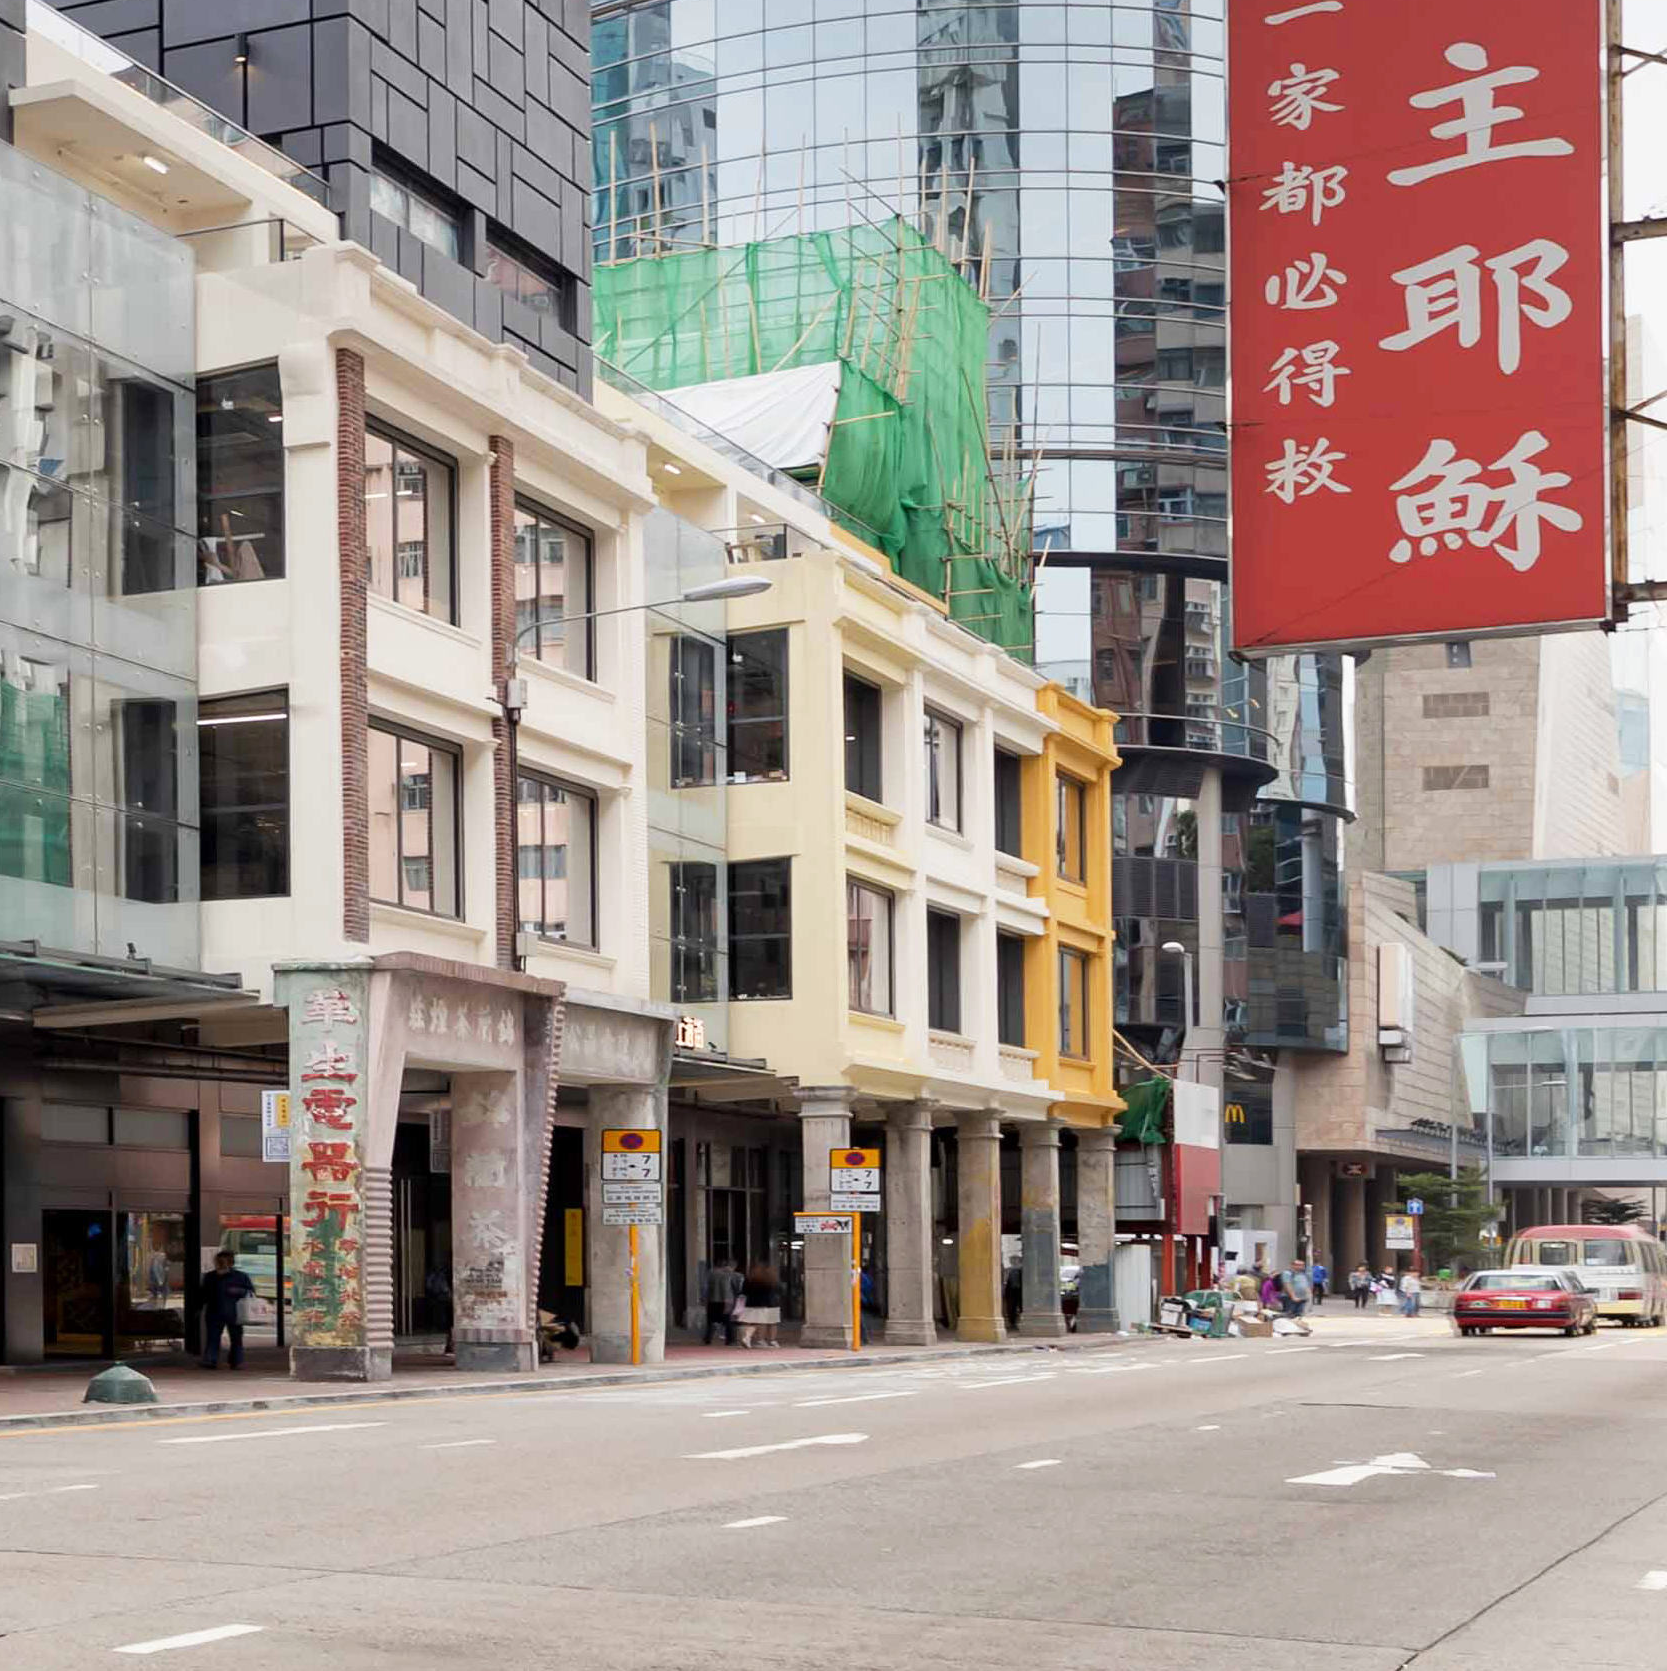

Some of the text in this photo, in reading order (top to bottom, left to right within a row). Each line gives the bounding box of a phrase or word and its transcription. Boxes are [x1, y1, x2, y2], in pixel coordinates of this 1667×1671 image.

[301, 988, 360, 1230] 華生電器行
